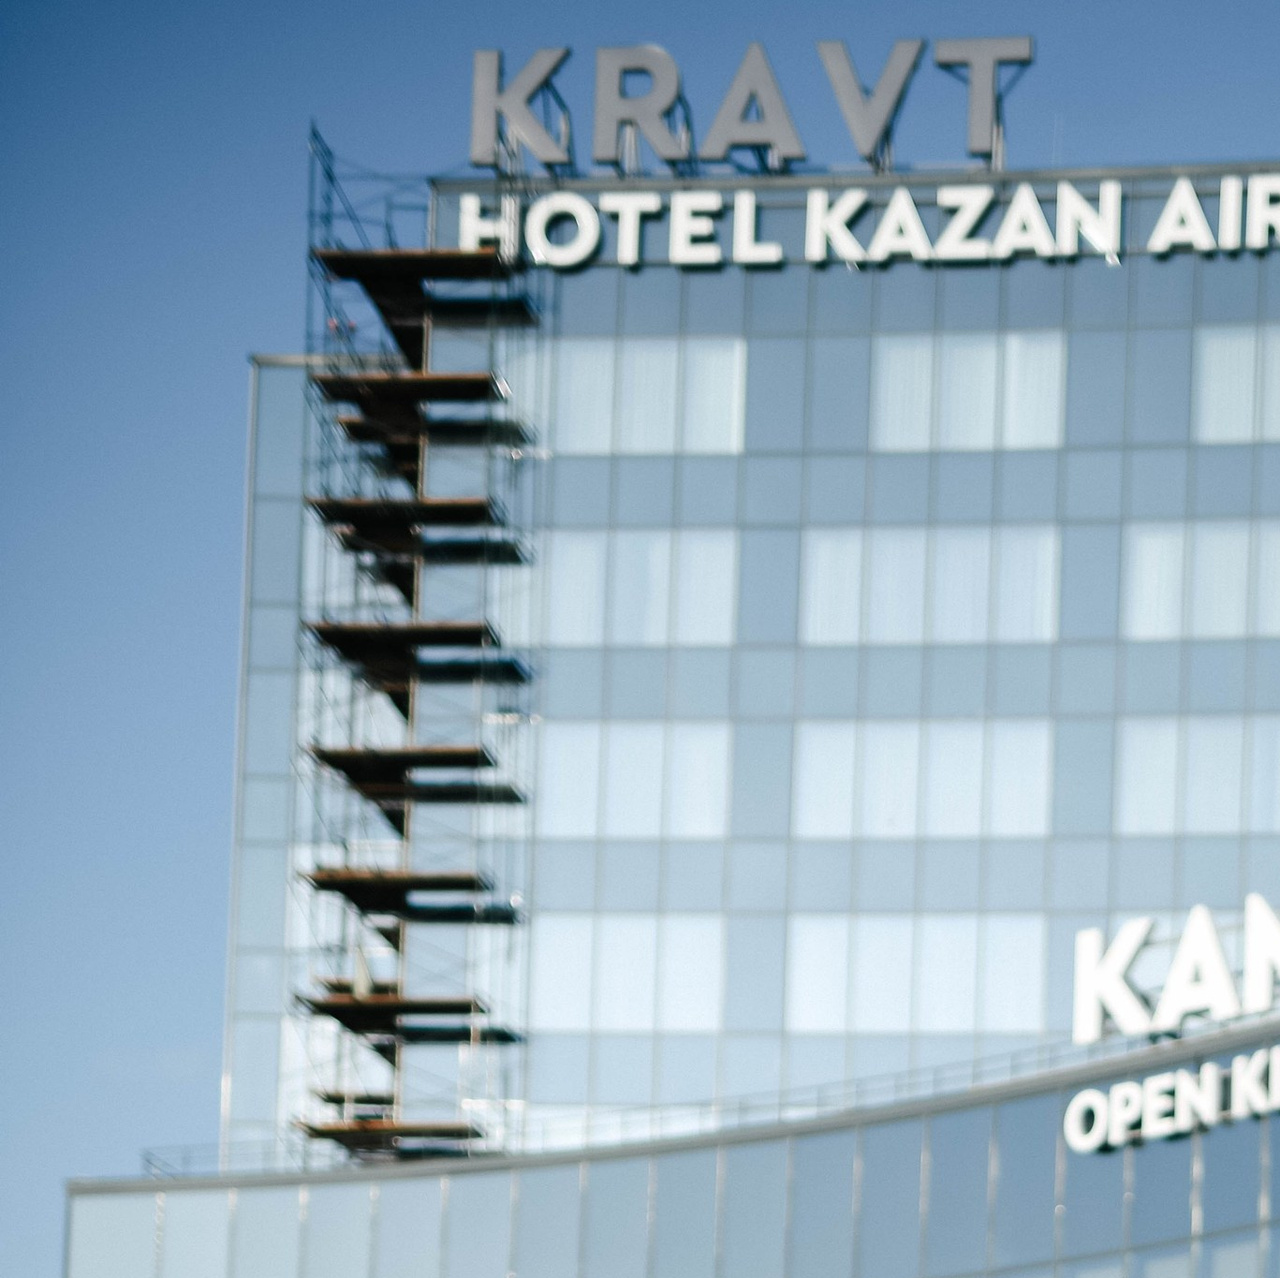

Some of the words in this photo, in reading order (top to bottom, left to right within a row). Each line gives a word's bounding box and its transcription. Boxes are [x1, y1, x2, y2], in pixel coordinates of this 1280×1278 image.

[469, 36, 1033, 165] KRAVT
[458, 189, 782, 268] HOTEL
[804, 181, 1121, 261] KAZAN
[1063, 1061, 1222, 1154] OPEN
